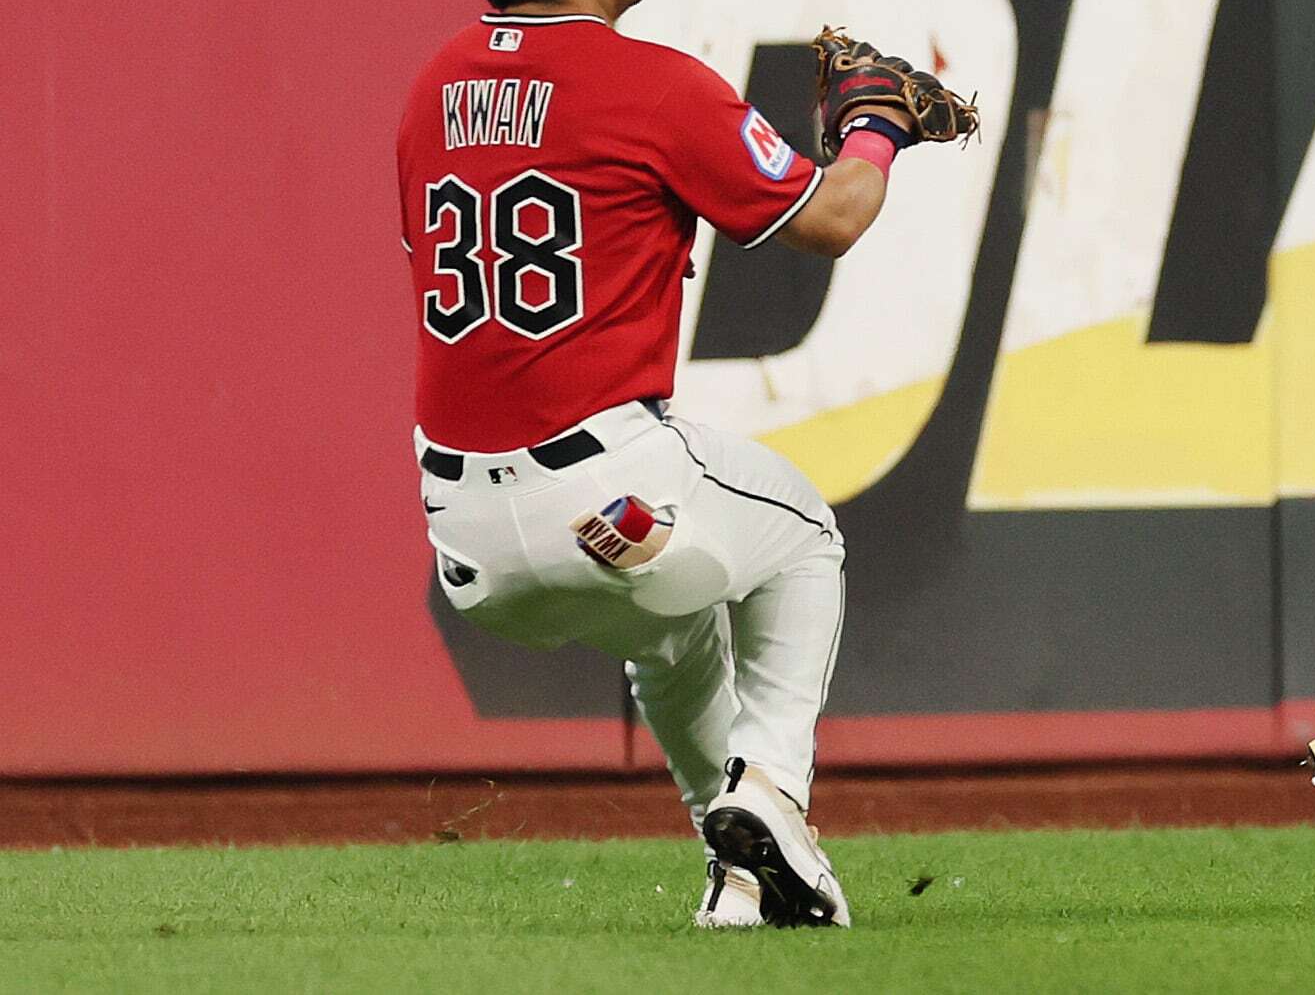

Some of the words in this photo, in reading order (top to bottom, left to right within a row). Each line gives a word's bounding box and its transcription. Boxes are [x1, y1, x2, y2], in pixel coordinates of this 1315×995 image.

[442, 78, 554, 151] KWAN
[423, 168, 584, 345] 38
[577, 515, 633, 562] KWAN
